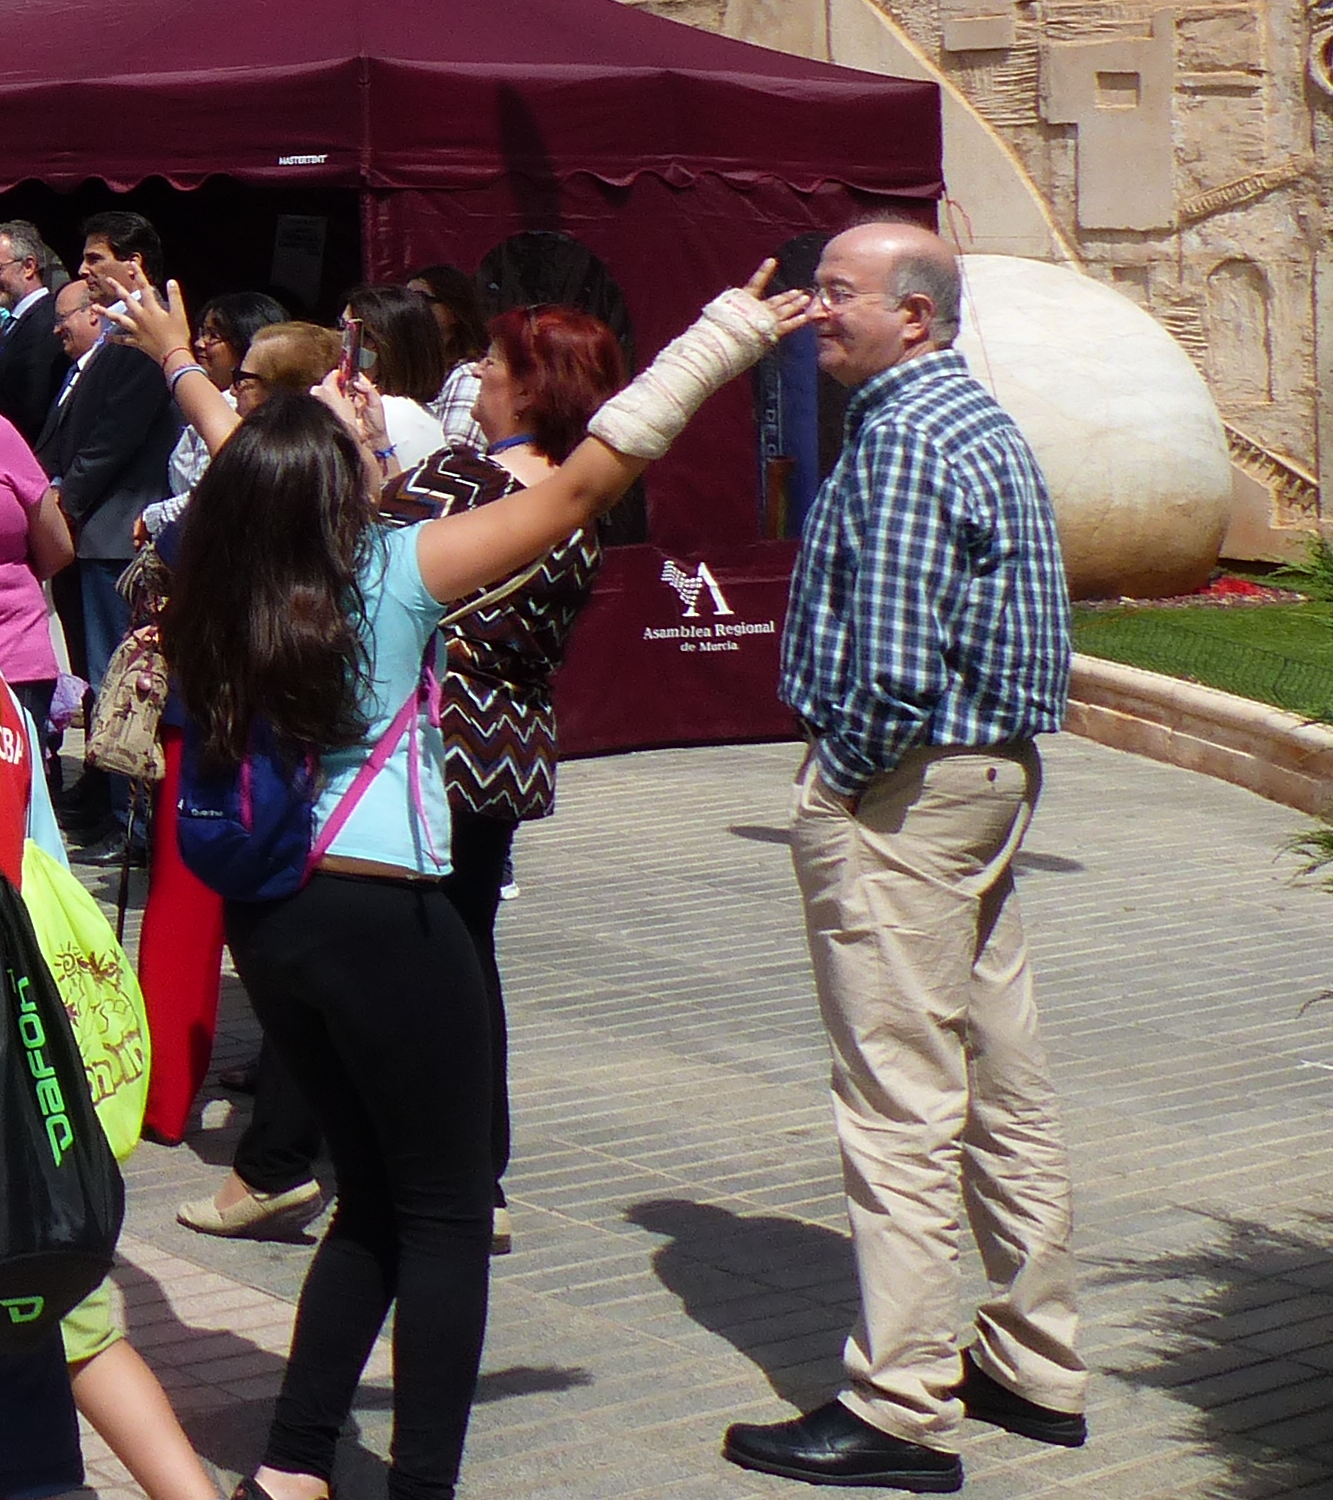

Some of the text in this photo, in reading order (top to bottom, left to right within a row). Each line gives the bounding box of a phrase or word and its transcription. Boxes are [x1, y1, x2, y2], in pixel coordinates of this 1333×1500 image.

[642, 620, 775, 640] Asamblea Regional
[679, 640, 740, 653] de Murcia
